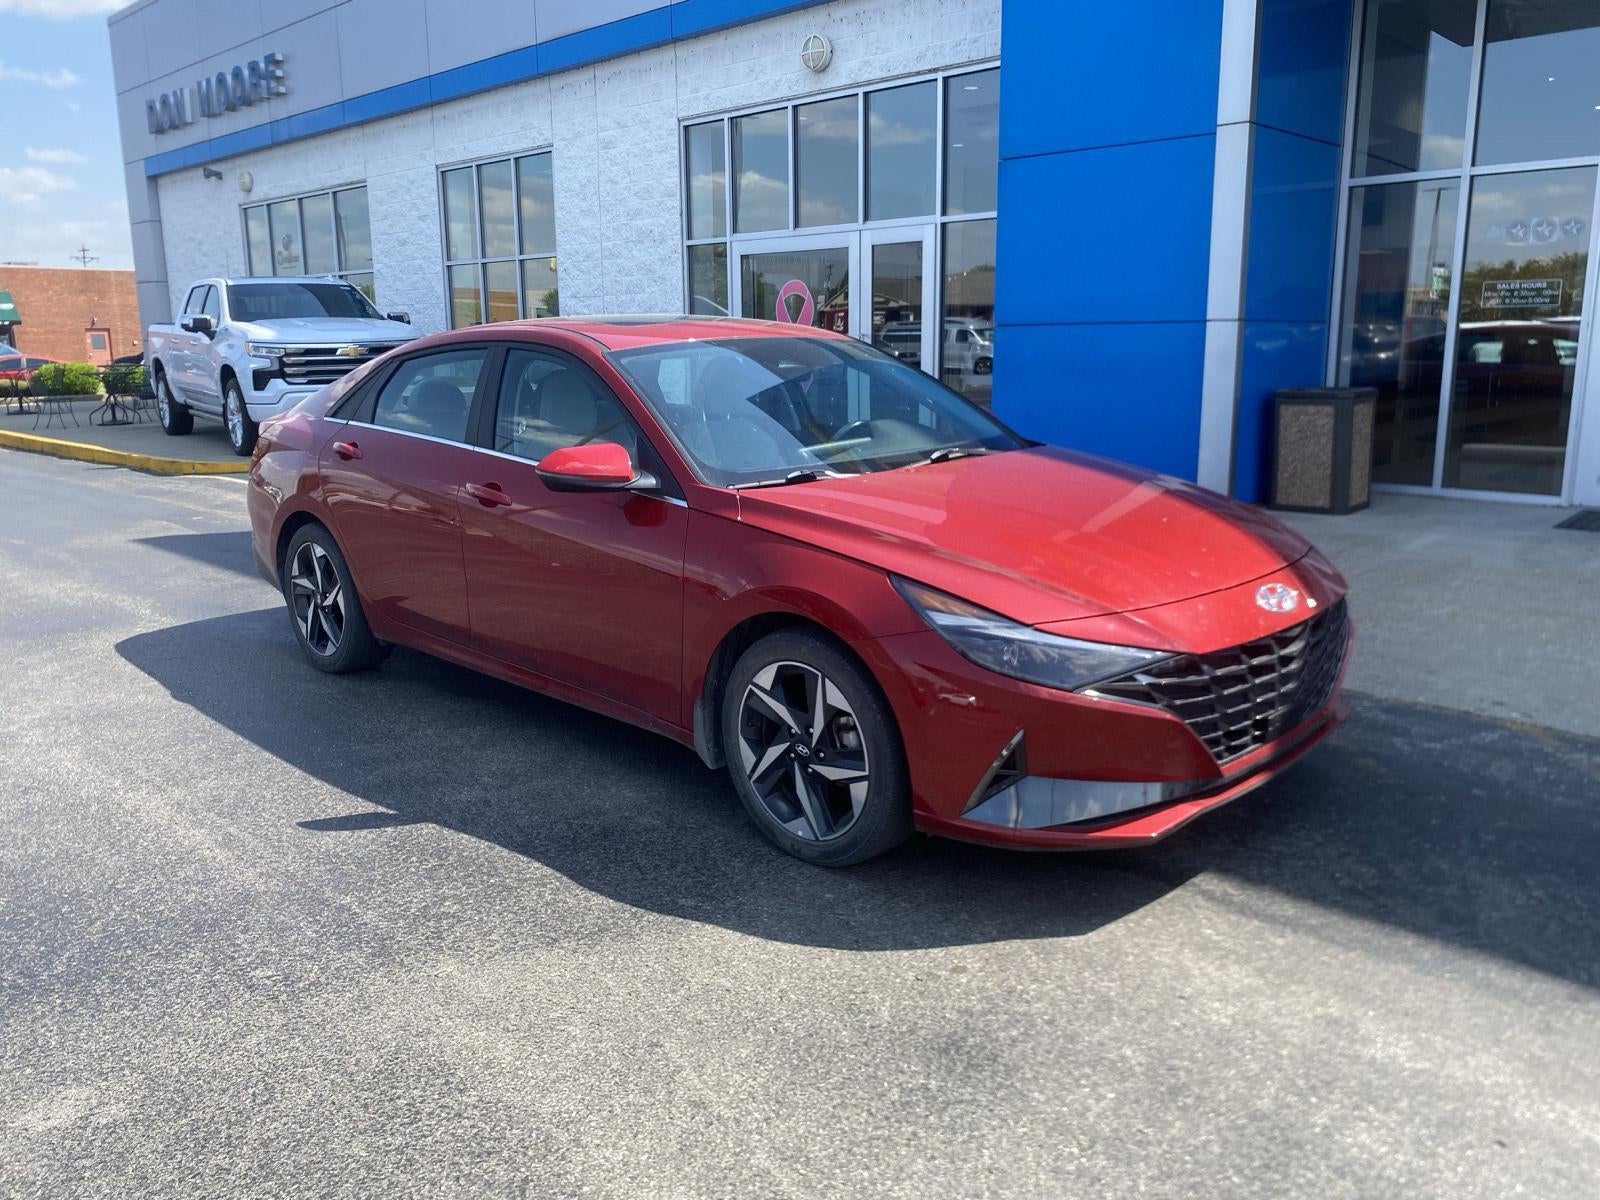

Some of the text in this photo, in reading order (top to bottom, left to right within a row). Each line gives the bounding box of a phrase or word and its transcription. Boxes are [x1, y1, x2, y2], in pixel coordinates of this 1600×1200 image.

[145, 52, 287, 134] DON MOORE
[1521, 281, 1547, 289] HOURS
